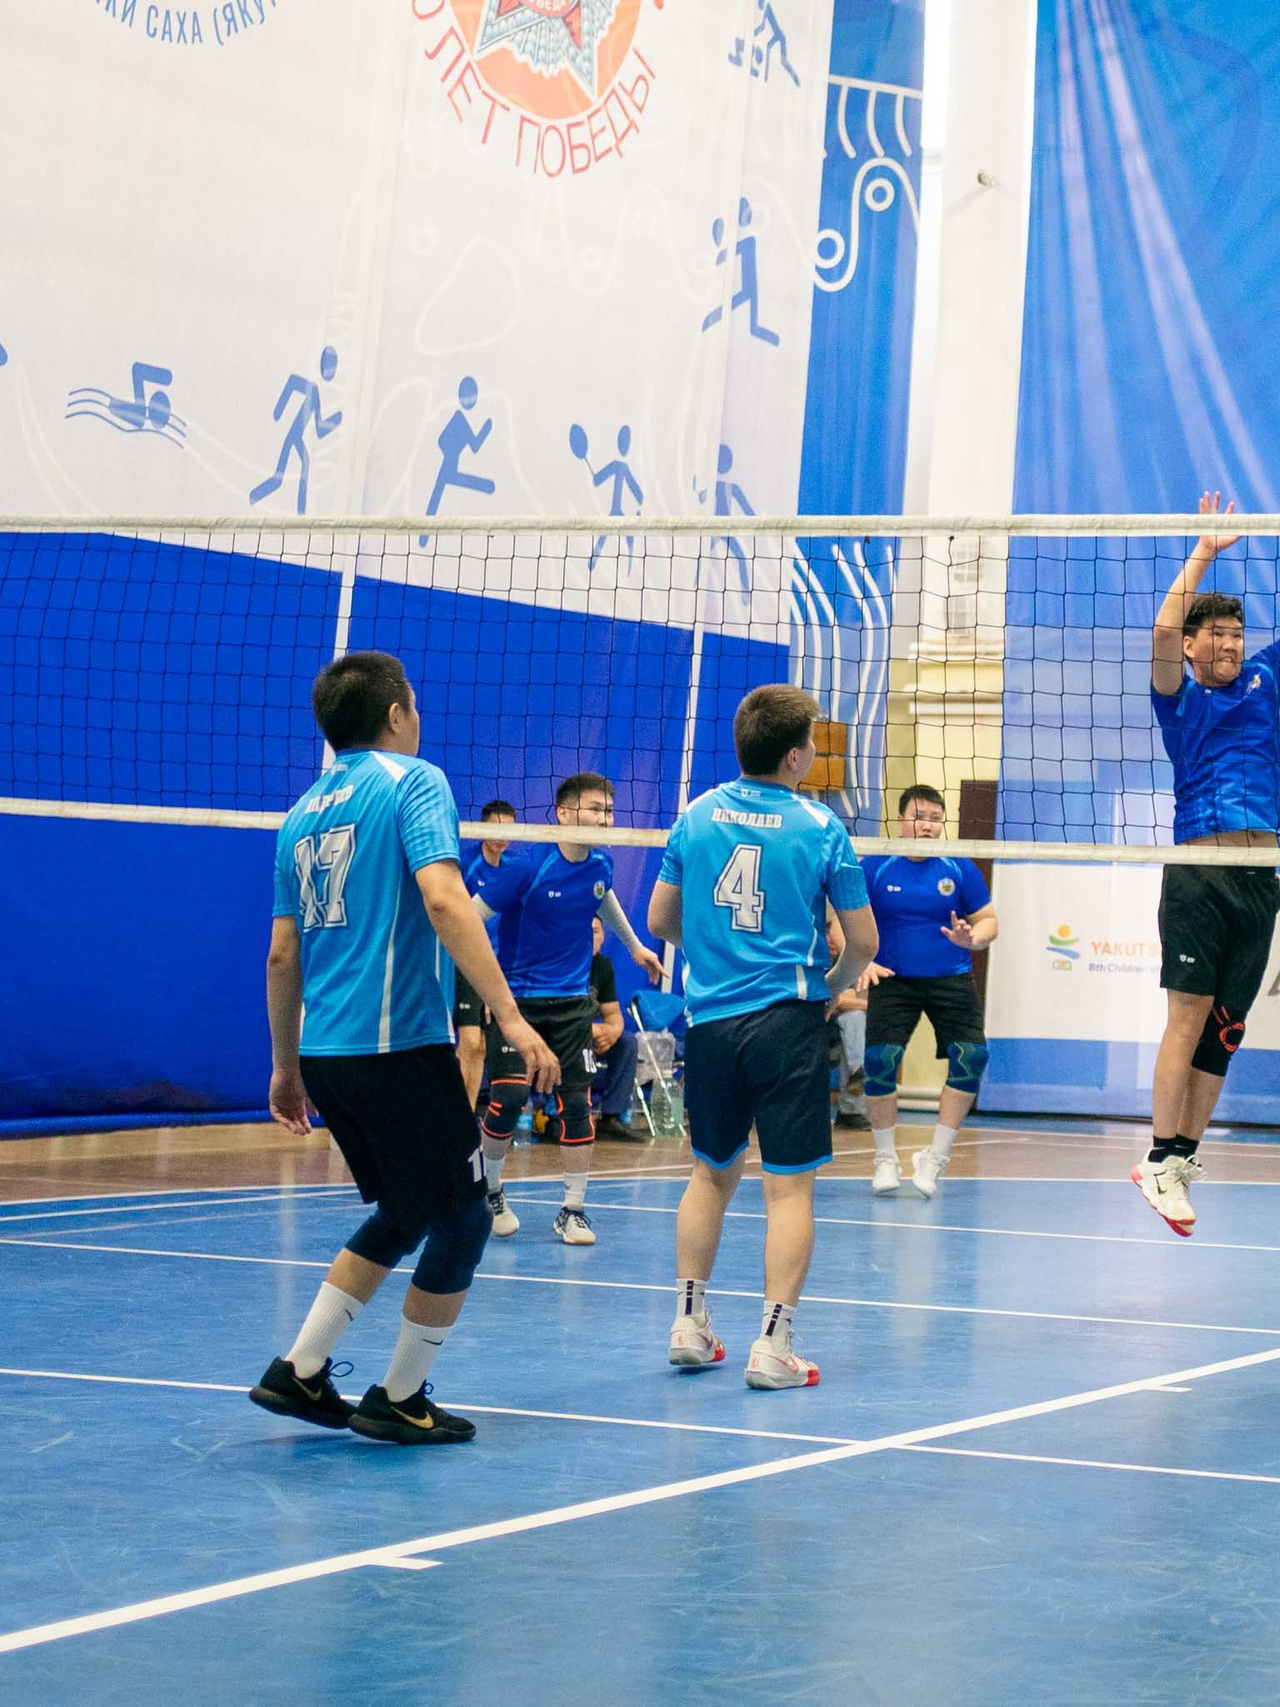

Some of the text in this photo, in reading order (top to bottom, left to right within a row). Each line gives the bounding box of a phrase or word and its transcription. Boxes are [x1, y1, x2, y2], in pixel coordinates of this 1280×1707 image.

[146, 4, 203, 44] САХА
[213, 0, 277, 46] (ЯКУ
[514, 47, 656, 178] ПОБЕДЫ
[294, 823, 356, 933] 17
[713, 843, 765, 933] 4
[1091, 940, 1162, 957] YAKUTS
